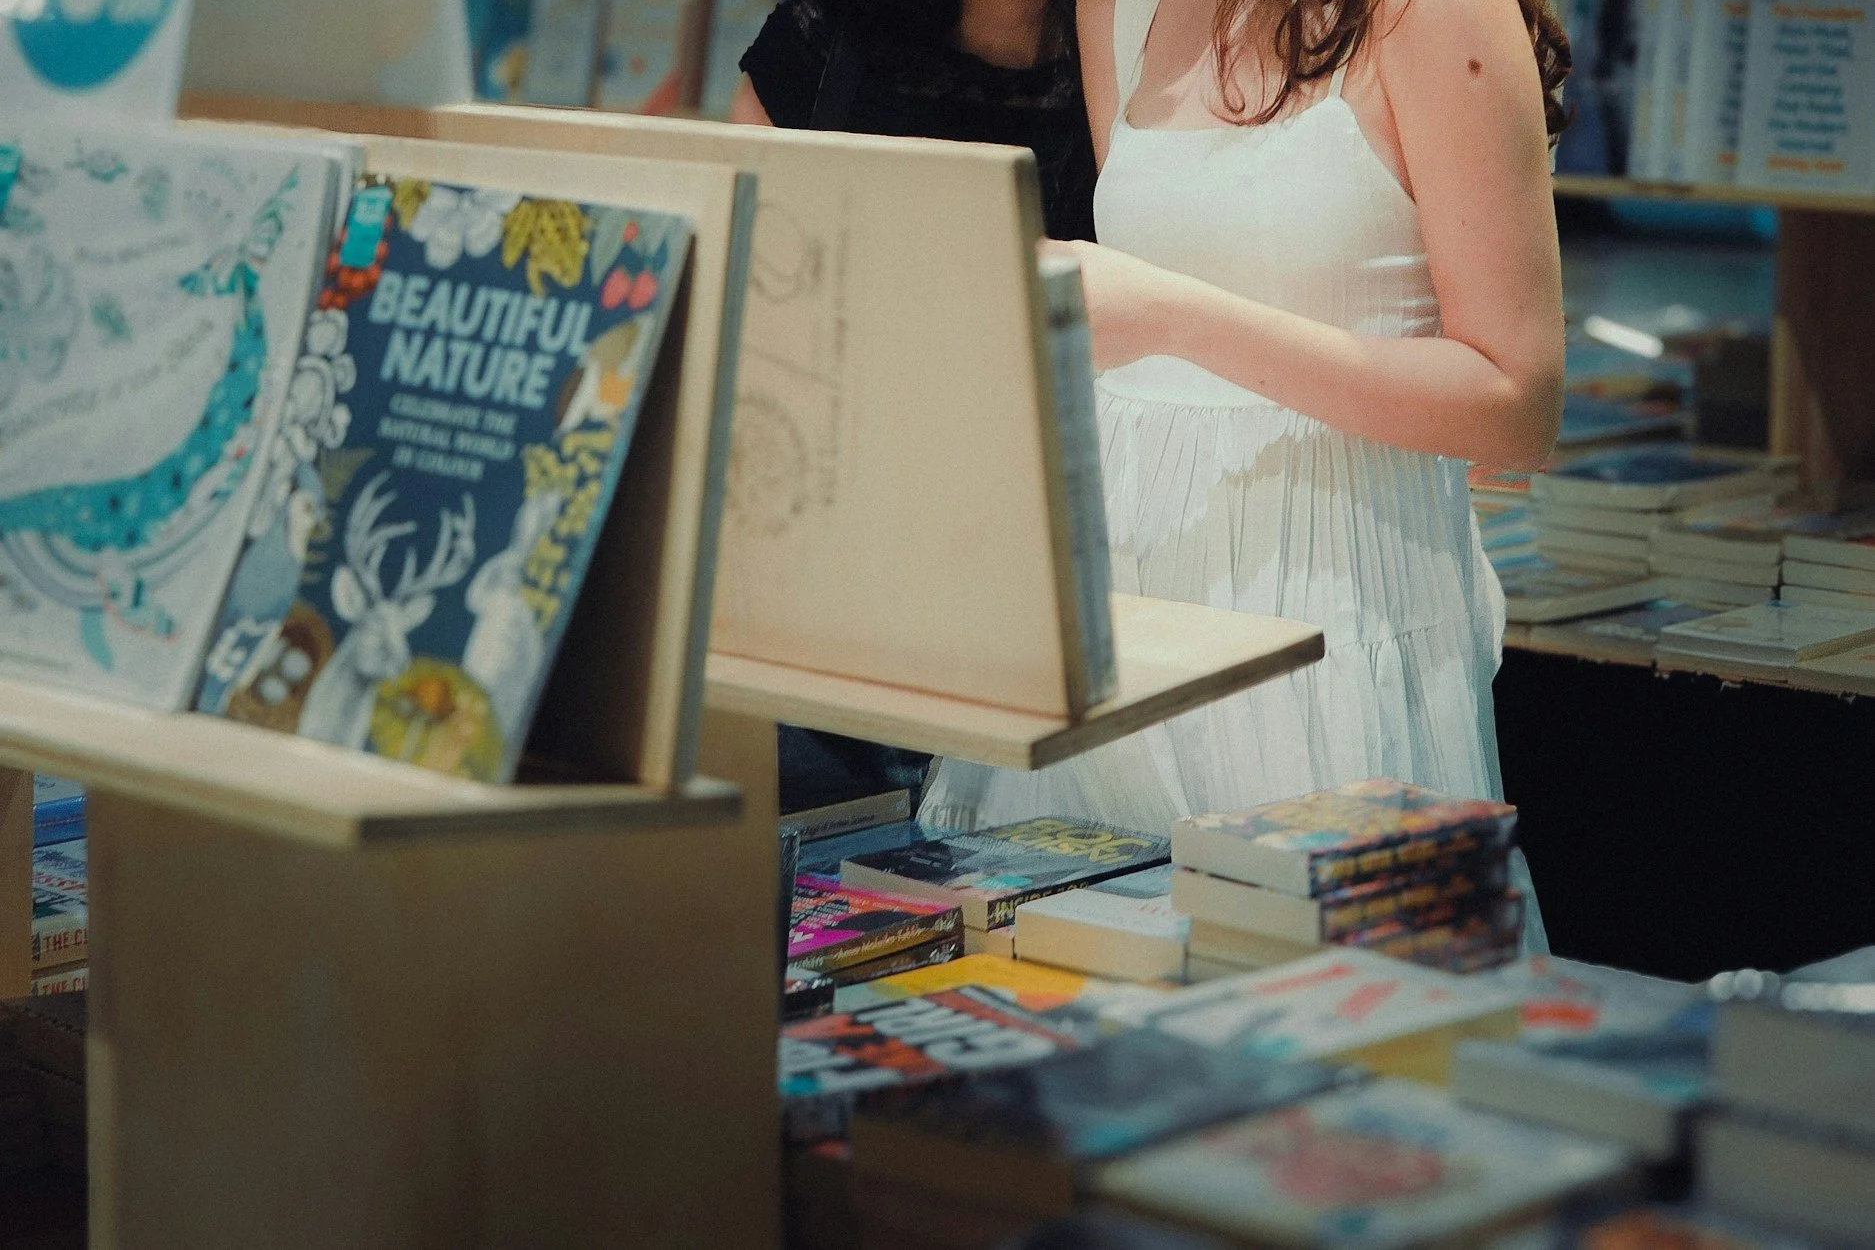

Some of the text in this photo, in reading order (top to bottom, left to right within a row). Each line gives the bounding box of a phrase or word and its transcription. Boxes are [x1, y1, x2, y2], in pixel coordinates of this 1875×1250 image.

[369, 271, 593, 357] BEAUTIFUL
[381, 330, 555, 408] NATURE
[43, 930, 69, 951] THE
